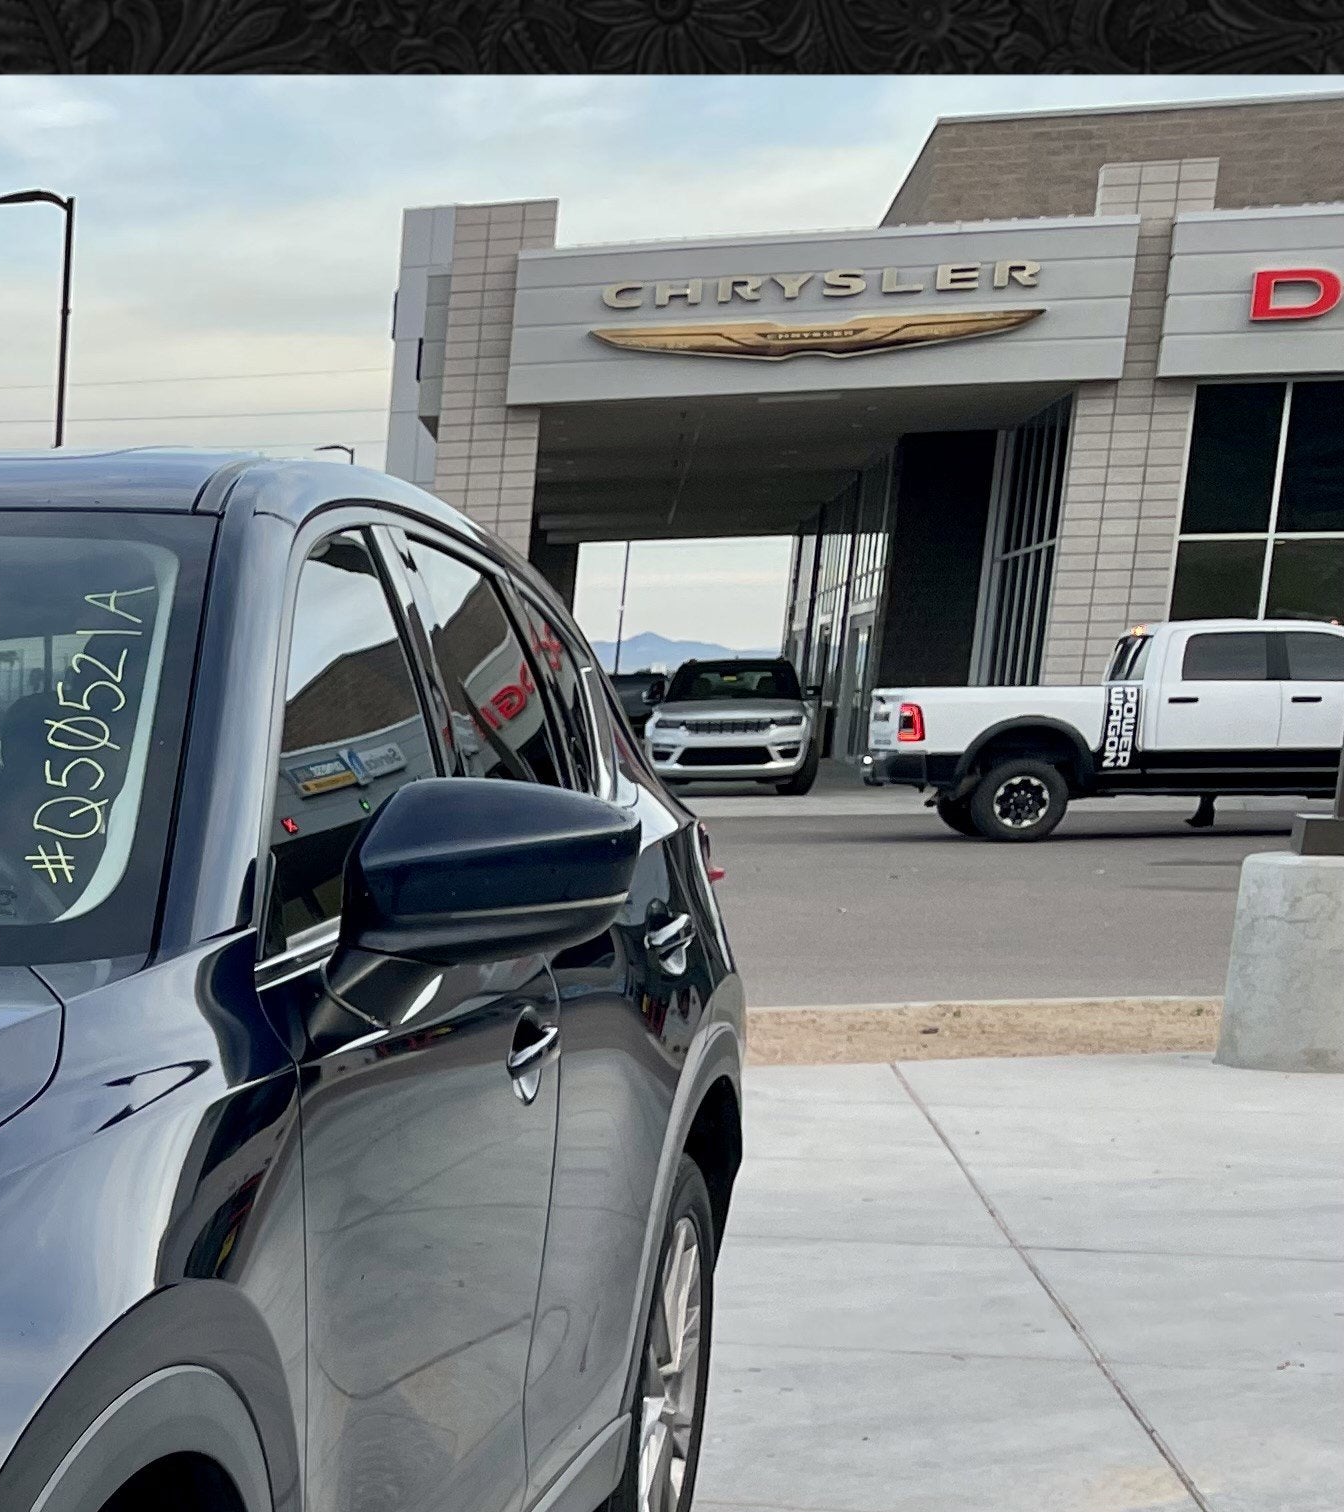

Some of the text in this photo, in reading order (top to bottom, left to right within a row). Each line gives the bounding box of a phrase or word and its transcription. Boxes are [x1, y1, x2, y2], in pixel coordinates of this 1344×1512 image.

[602, 260, 1041, 308] CHRYSLER
[1250, 267, 1341, 320] D
[1102, 687, 1123, 768] WAGON
[1116, 687, 1138, 767] POWER
